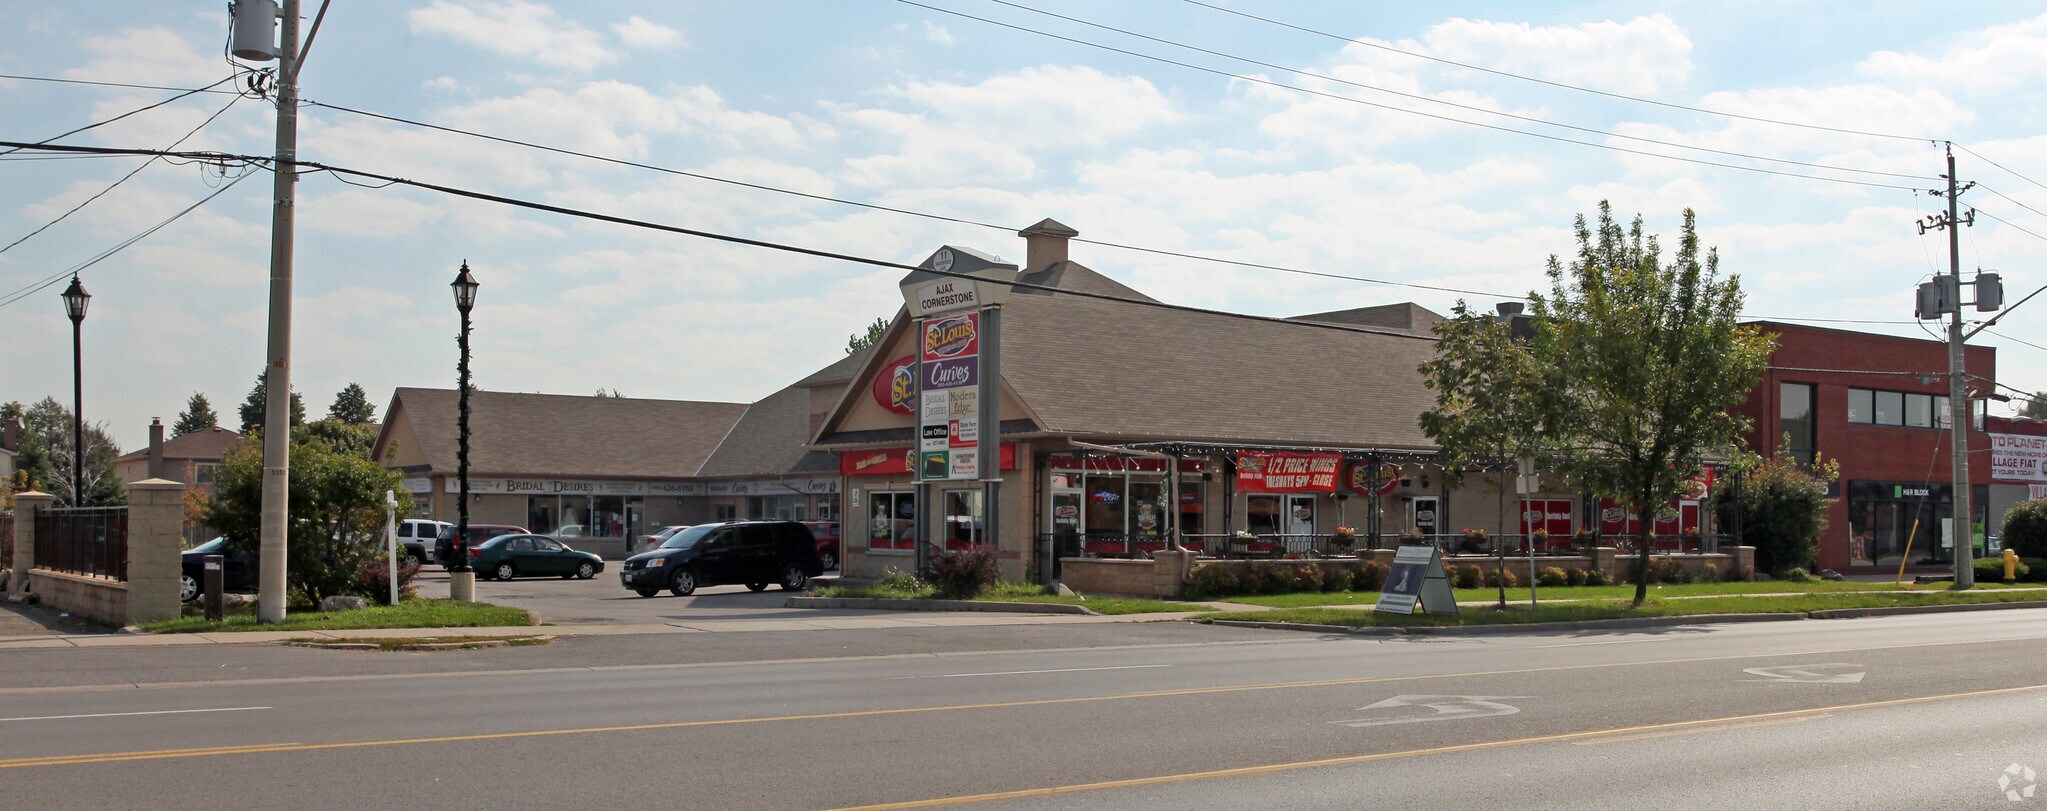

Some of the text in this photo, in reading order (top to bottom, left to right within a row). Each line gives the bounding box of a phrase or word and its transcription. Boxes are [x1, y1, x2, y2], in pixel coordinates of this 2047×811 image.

[941, 251, 947, 260] 11
[936, 283, 954, 295] AJAX
[922, 292, 974, 309] CORNERSTONE
[941, 323, 972, 345] Louis
[931, 362, 969, 385] Curves
[950, 390, 976, 402] Modern
[954, 402, 971, 415] Edge
[933, 427, 947, 436] Office
[1992, 436, 2046, 449] TO PLANET
[1268, 457, 1338, 474] 1/2 PRICE WINGS
[1993, 457, 2037, 468] LLAGE FIAT
[506, 480, 545, 492] BRIDAL
[553, 481, 594, 492] DESIRES
[1266, 475, 1295, 488] TUESDAYS
[1312, 474, 1334, 487] CLOSE
